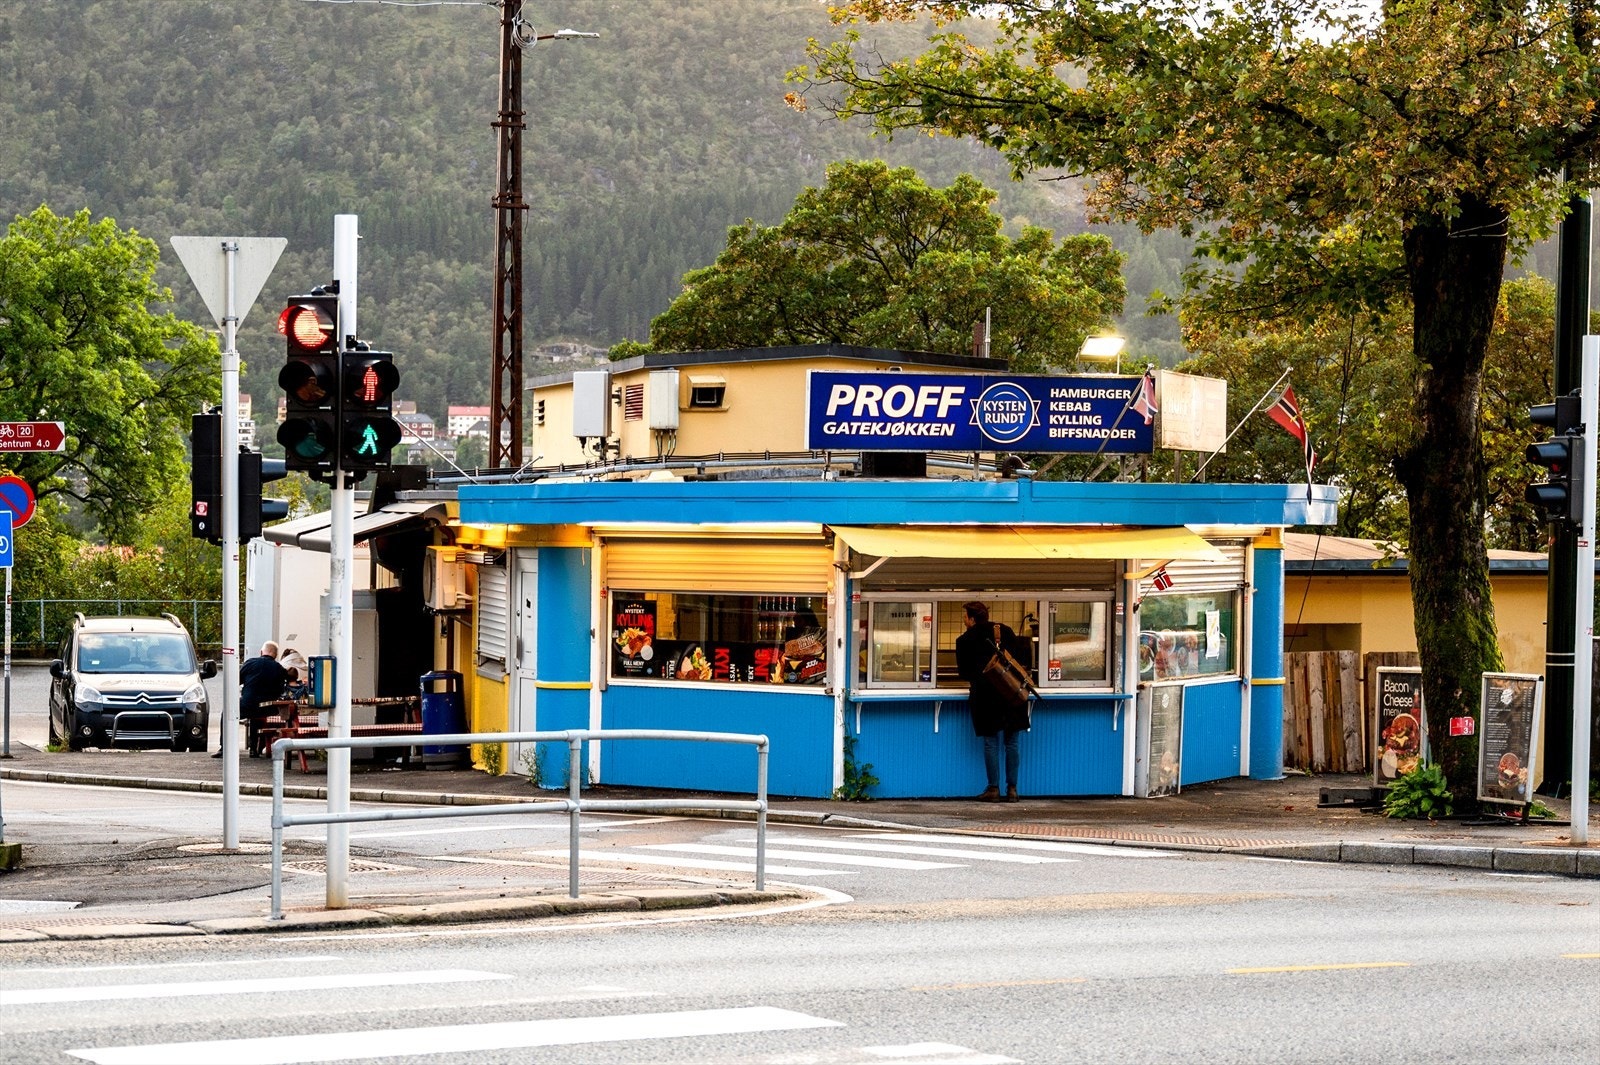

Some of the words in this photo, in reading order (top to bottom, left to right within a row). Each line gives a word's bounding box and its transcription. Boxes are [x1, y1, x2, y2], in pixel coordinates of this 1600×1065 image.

[1050, 388, 1131, 400] HAMBURGER
[825, 384, 966, 418] PROFF
[982, 400, 1027, 412] KYSTEN
[1049, 401, 1092, 412] KEBAB
[984, 412, 1026, 424] RUNDT
[1049, 414, 1102, 426] KYLLING
[20, 426, 31, 436] 20
[822, 421, 956, 437] GATEKJØKKEN
[1048, 427, 1136, 439] BIFFSNADDER
[616, 613, 654, 628] KYLLING
[1384, 679, 1409, 693] Bacon
[1383, 693, 1413, 707] Cheese
